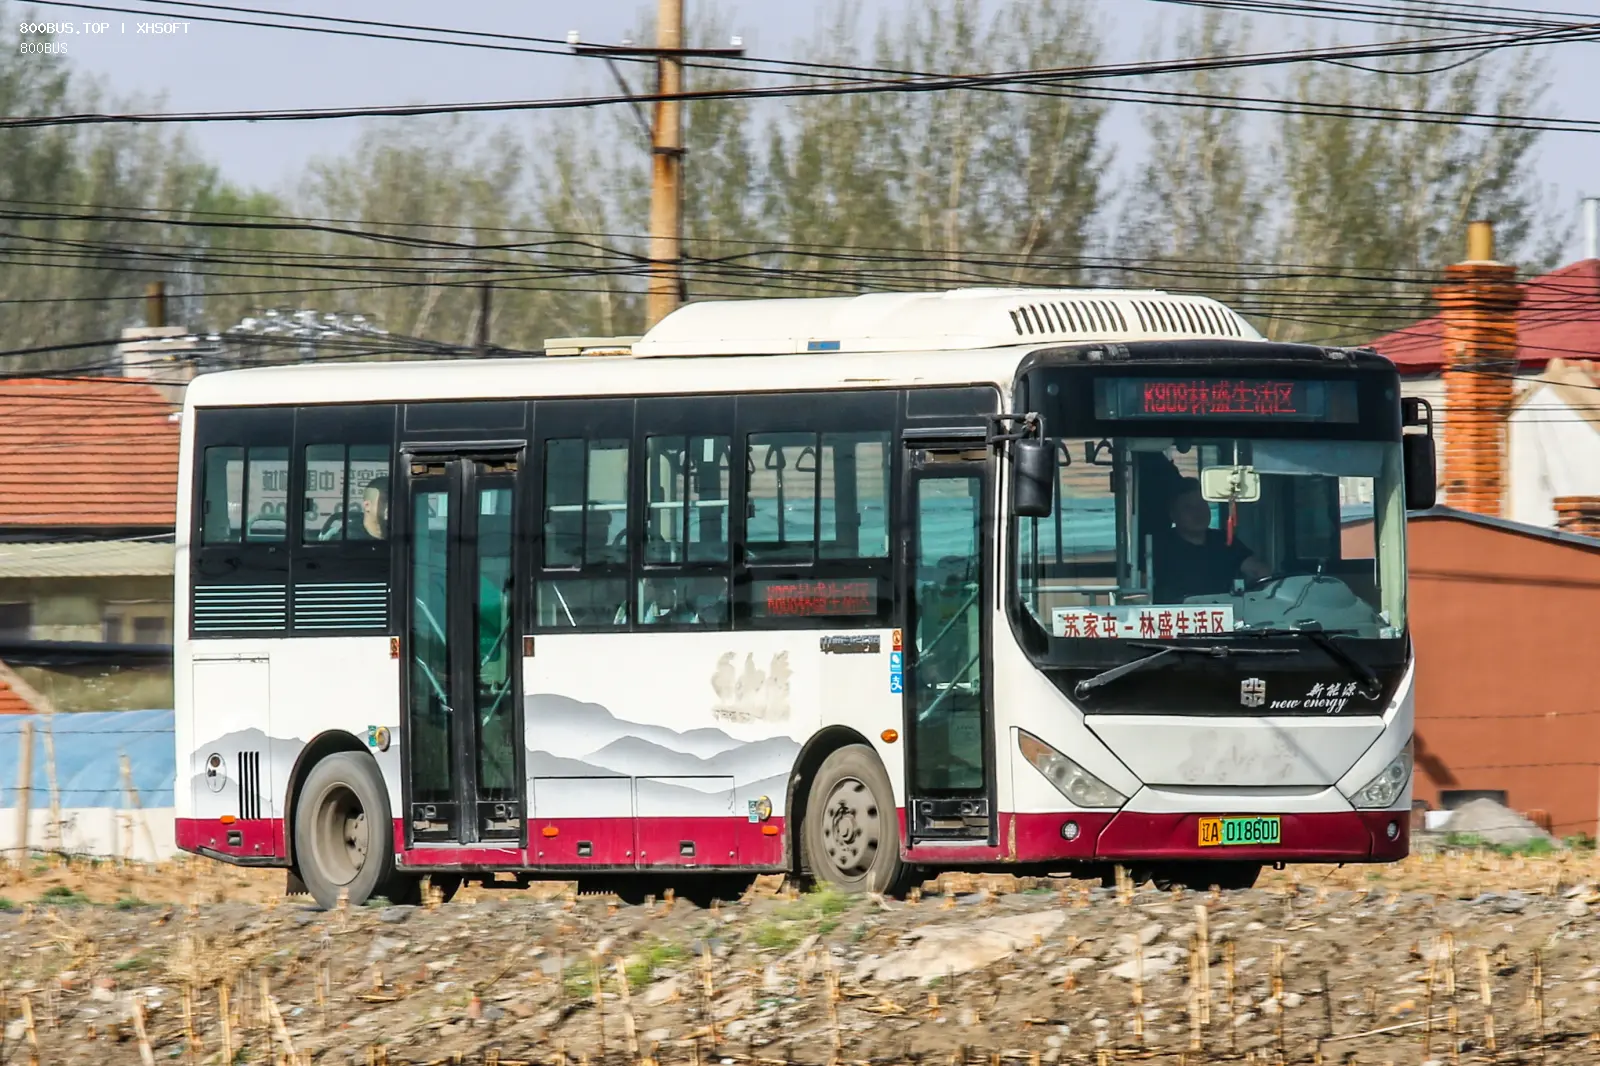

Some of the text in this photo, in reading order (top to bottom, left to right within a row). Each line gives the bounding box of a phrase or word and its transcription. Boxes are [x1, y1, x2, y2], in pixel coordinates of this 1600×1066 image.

[1306, 681, 1358, 698] 新能源
[1270, 696, 1348, 714] new energy
